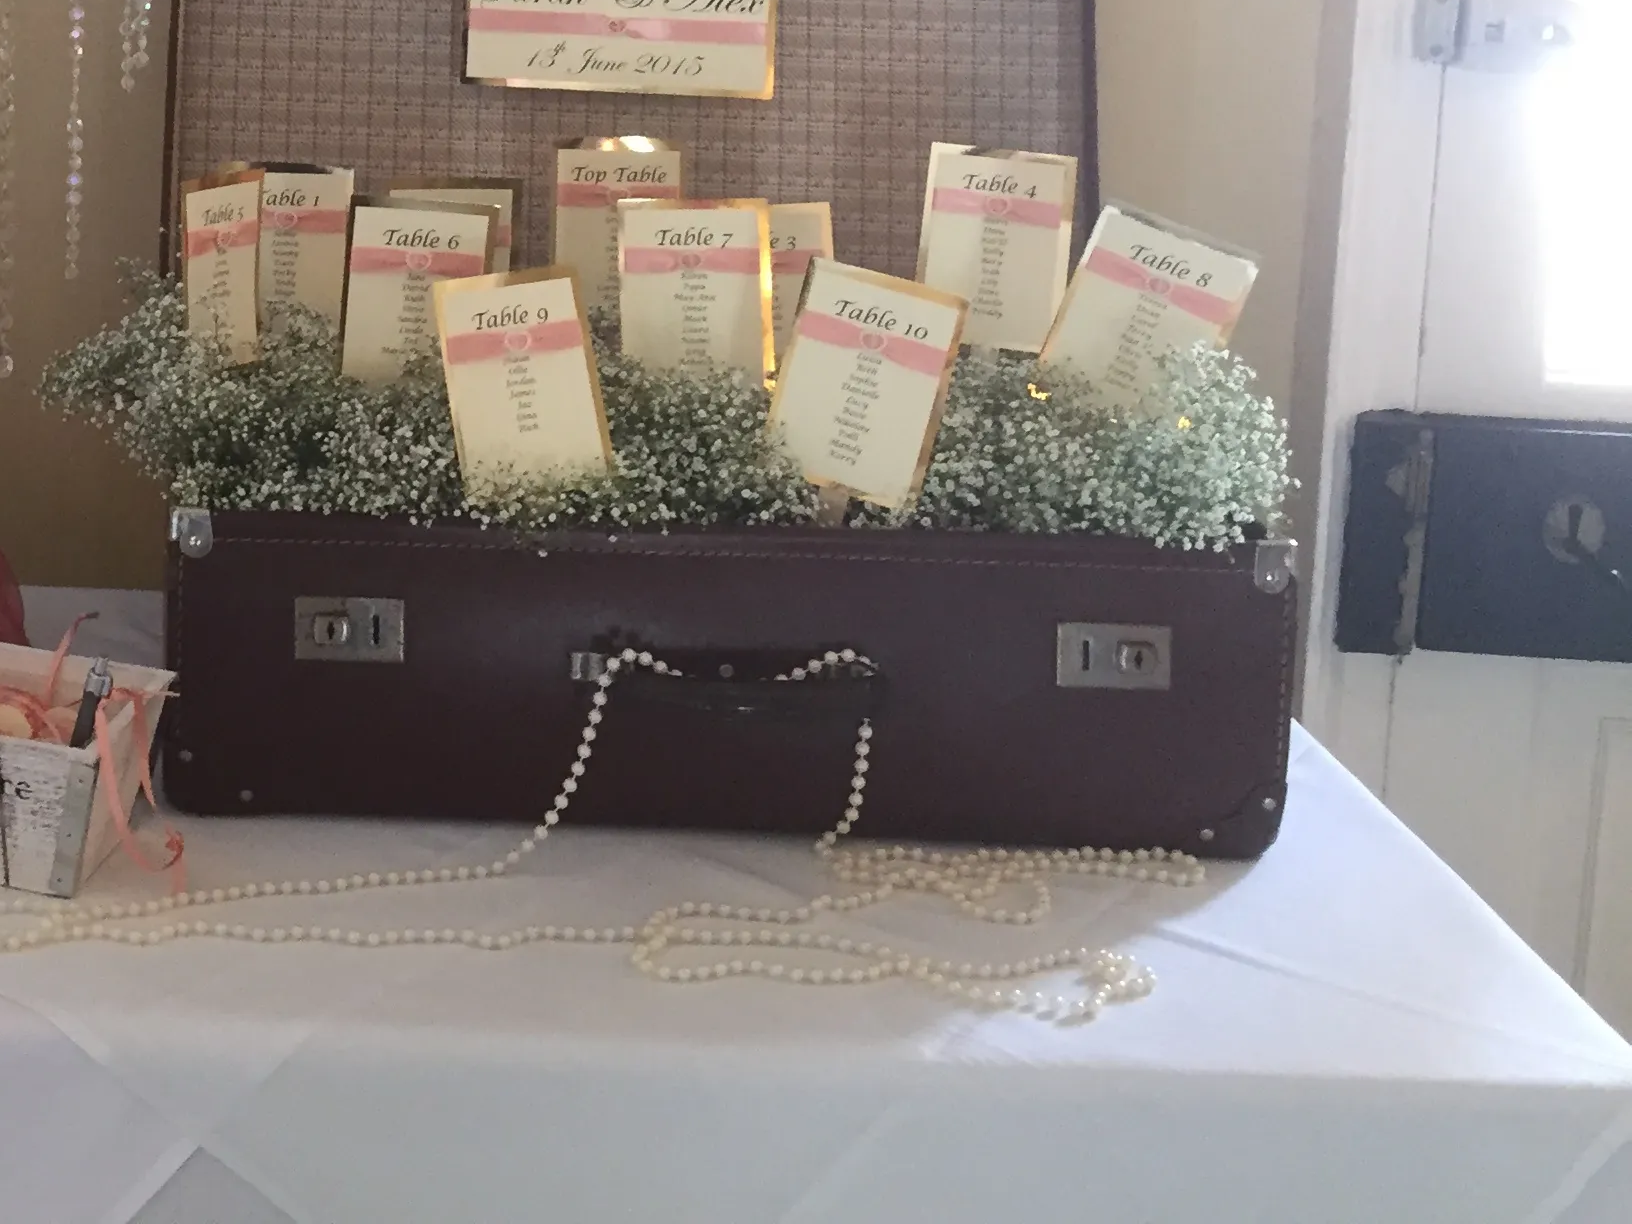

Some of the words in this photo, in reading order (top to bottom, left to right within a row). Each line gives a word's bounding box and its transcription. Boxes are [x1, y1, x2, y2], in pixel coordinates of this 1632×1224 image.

[567, 44, 627, 75] June
[633, 54, 706, 77] 2015
[571, 165, 607, 185] Top
[613, 167, 667, 184] Table
[962, 173, 1018, 194] Table
[1024, 185, 1038, 199] 4
[314, 195, 320, 207] 1
[201, 202, 234, 226] Table
[382, 228, 440, 249] Table
[447, 233, 460, 249] 6
[654, 227, 714, 247] Table
[720, 233, 734, 249] 7
[786, 236, 797, 251] 3
[1130, 243, 1192, 280] Table
[1196, 271, 1213, 288] 8
[471, 304, 529, 331] Table
[536, 307, 549, 324] 9
[834, 299, 898, 331] Table
[905, 322, 929, 342] 10
